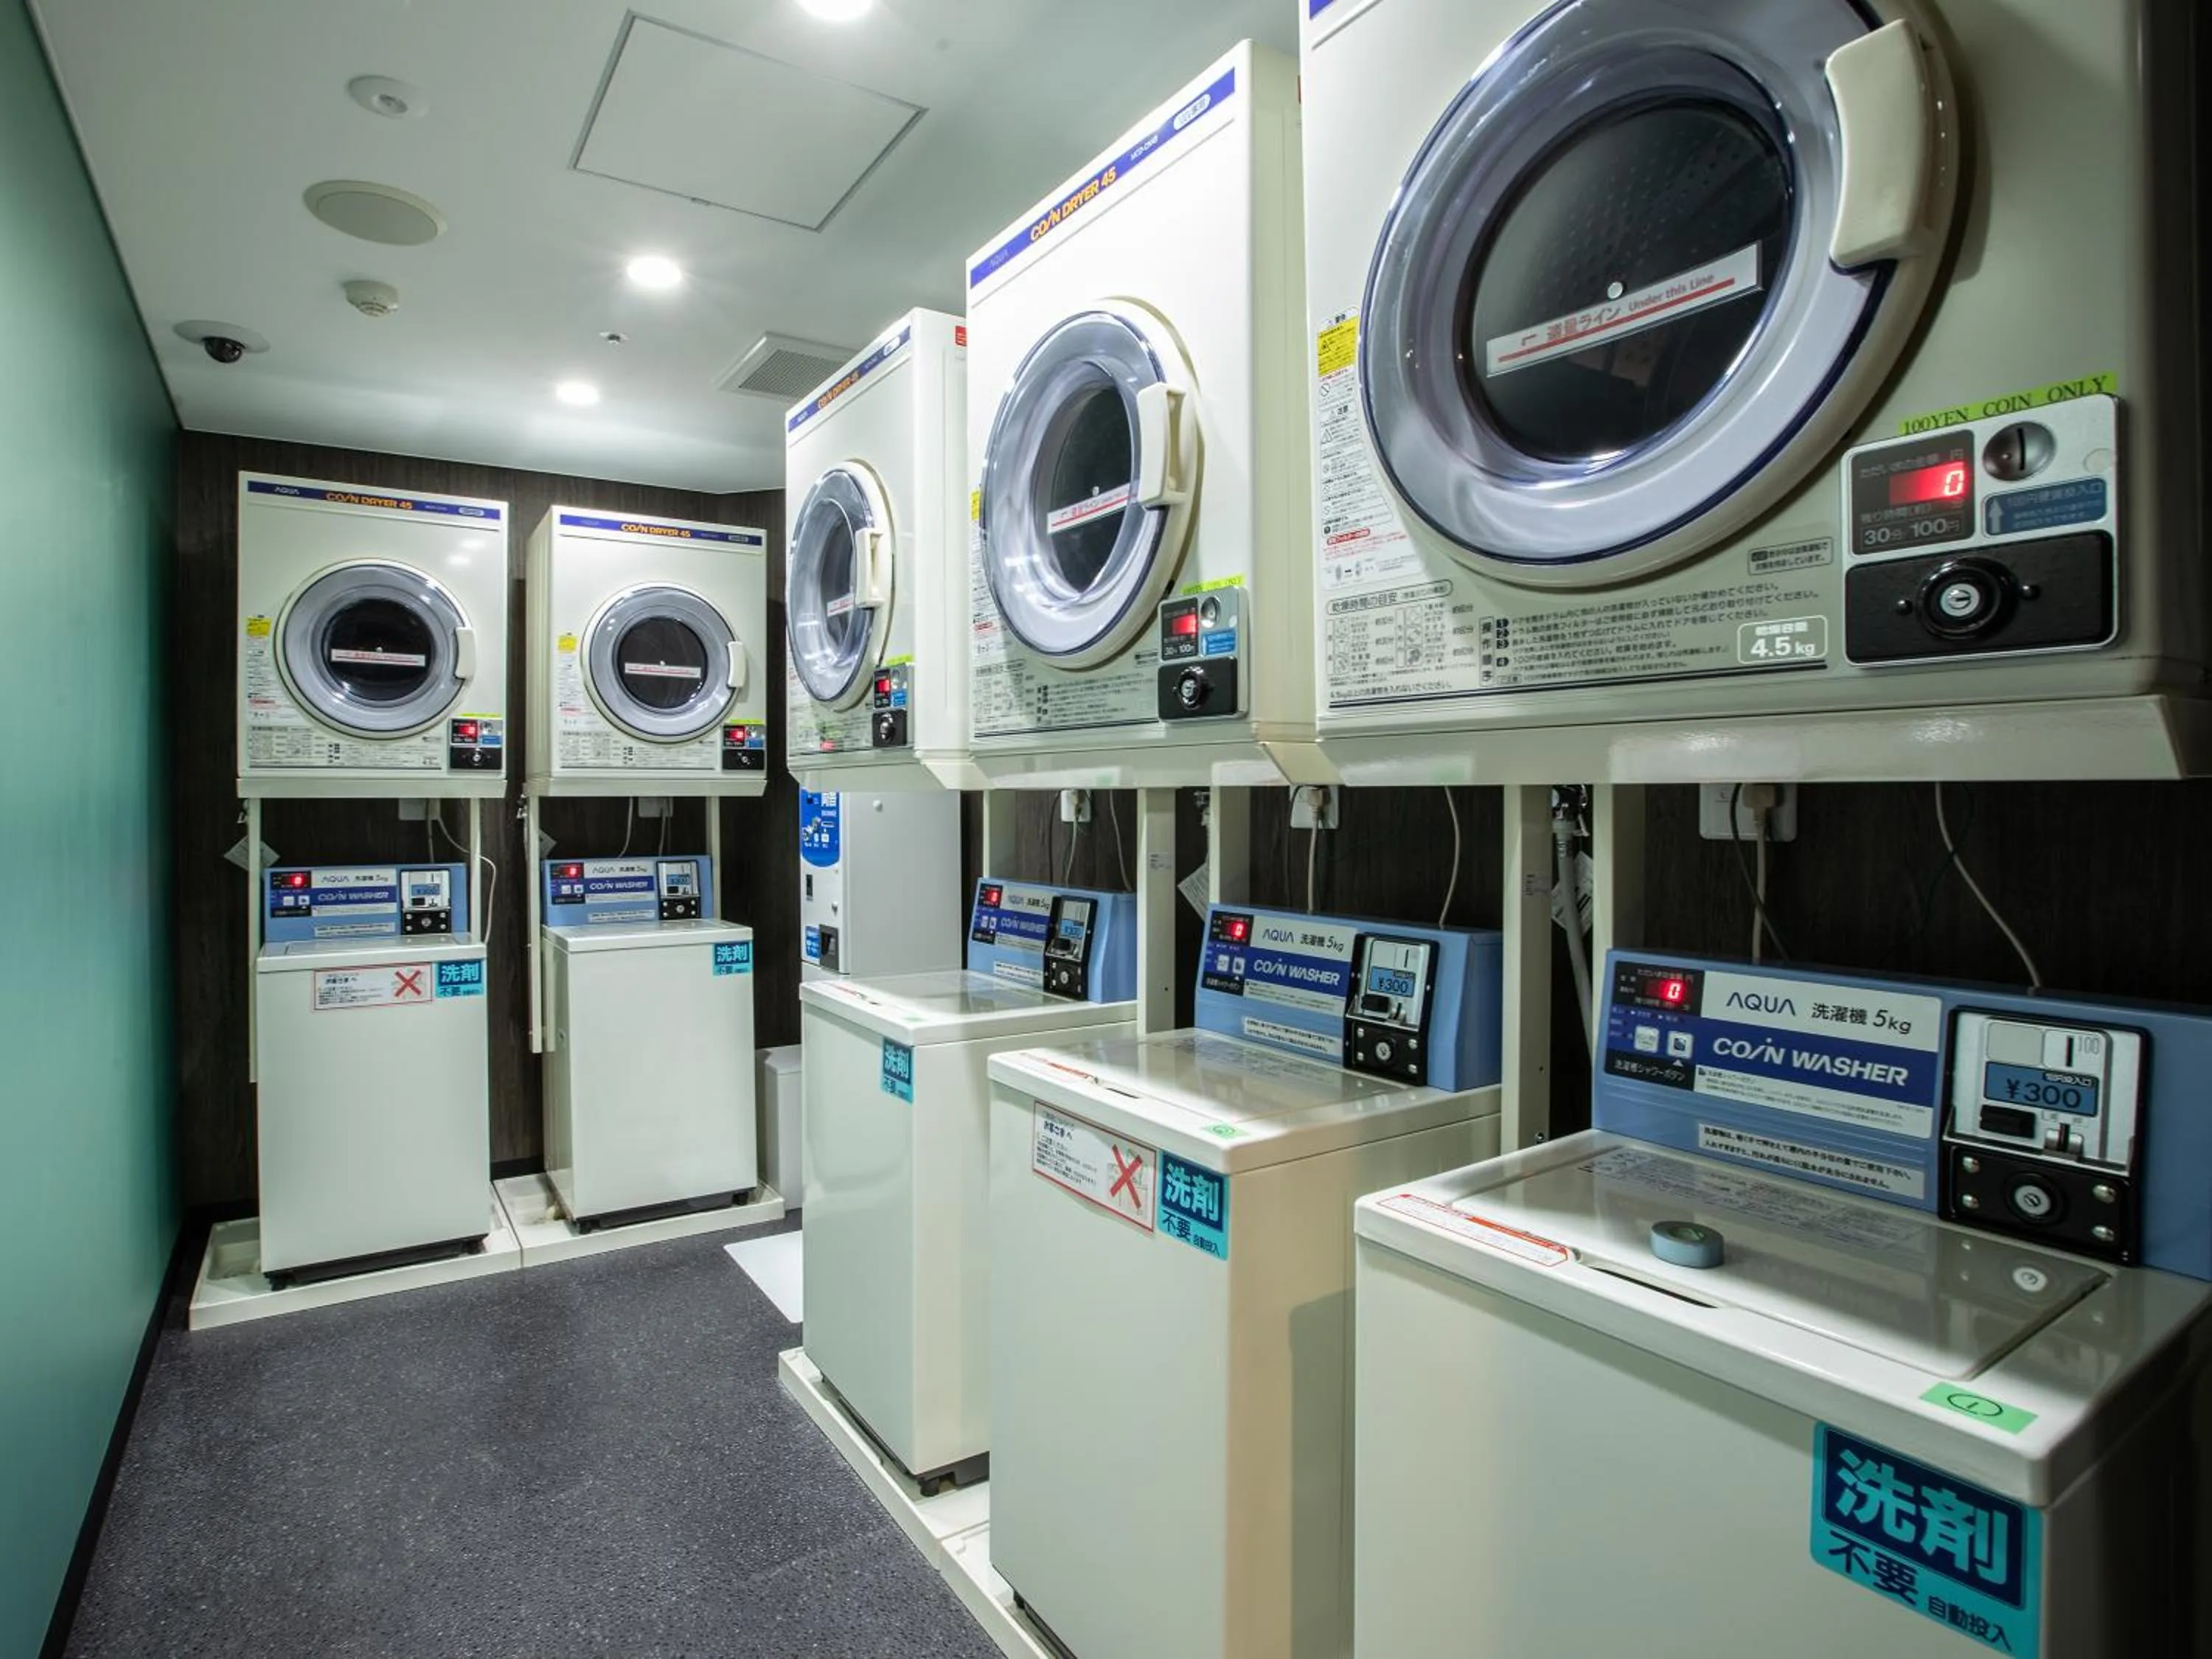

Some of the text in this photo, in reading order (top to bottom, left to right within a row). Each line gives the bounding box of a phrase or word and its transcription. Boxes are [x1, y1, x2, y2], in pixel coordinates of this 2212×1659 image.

[1061, 180, 1099, 220] DRYER
[1102, 166, 1116, 187] 45
[1628, 274, 1714, 313] Under this Line
[1546, 307, 1620, 340] 適量ライン
[1904, 375, 2107, 436] 100YEN COIN ONLY
[1944, 470, 1964, 496] 0
[361, 497, 397, 508] DRYER
[400, 501, 412, 509] 45
[1332, 592, 1397, 613] 乾燥時間の目安
[1750, 636, 1815, 656] 4.5 kg
[321, 875, 349, 883] AQUA
[348, 891, 389, 901] WASHER
[717, 945, 747, 963] 洗剤
[1262, 928, 1345, 953] AQUA 洗濯機 5kg
[442, 963, 479, 984] 洗剤
[1290, 967, 1340, 987] WASHER
[1377, 976, 1408, 994] ¥300
[1668, 983, 1681, 1000] 0
[1726, 992, 1913, 1035] AQUA 洗濯機 5kg
[885, 1044, 908, 1079] 洗剤
[1792, 1048, 1910, 1087] WASHER
[2006, 1079, 2081, 1109] ¥300
[1165, 1163, 1219, 1222] 洗剤
[1162, 1209, 1192, 1242] 不要
[1835, 1449, 2008, 1585] 洗剤
[1828, 1530, 2012, 1652] 不要 自動投入
